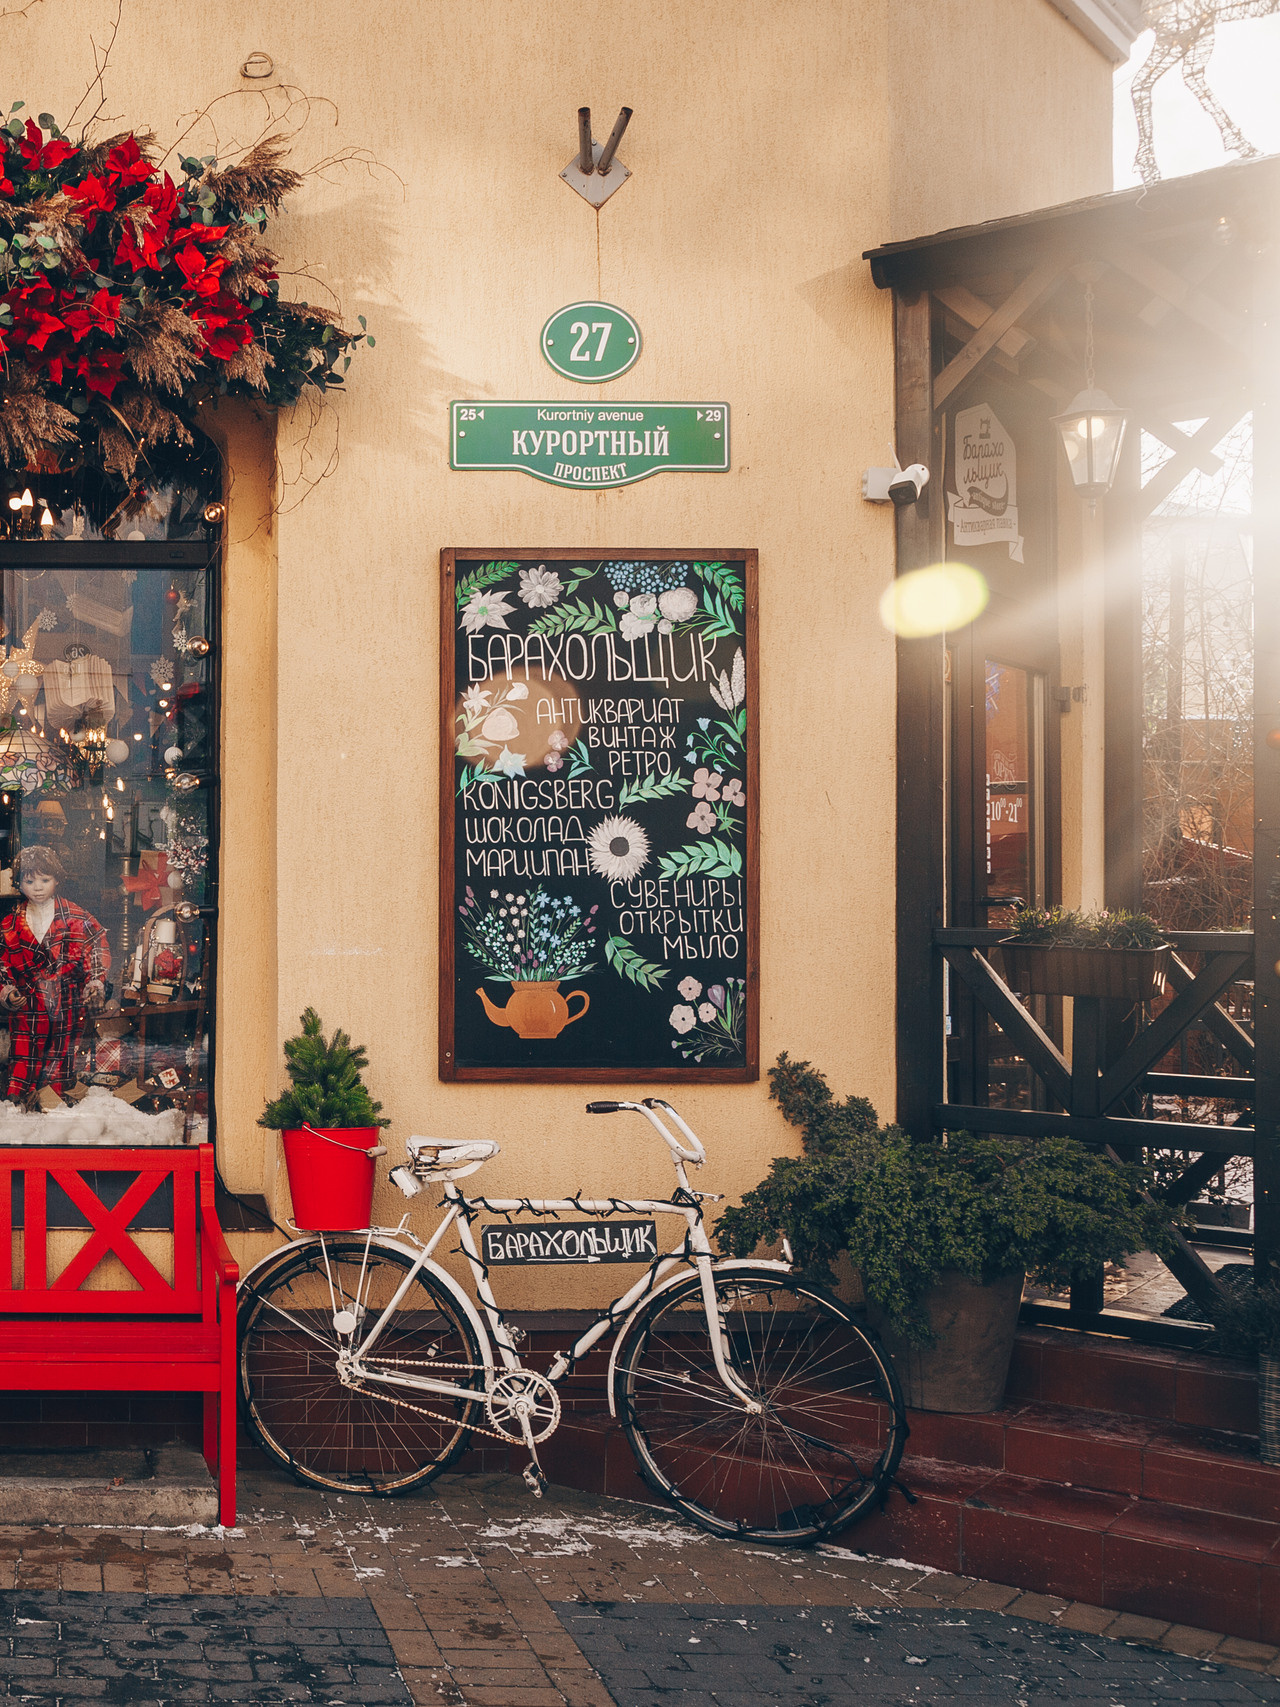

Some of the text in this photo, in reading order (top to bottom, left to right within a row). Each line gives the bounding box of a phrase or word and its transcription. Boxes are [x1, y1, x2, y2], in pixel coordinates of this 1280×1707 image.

[570, 321, 612, 362] 27
[459, 408, 477, 421] 25
[537, 409, 644, 423] Kurortniy avenue
[705, 409, 721, 421] 29
[511, 425, 670, 456] КУРОРТНЫЙ
[962, 434, 1005, 461] Барахо
[552, 461, 627, 481] ПРОСПЕКТ
[468, 632, 721, 689] БАРАХОЛЬЩИК
[535, 697, 685, 725] АНТИКВАРИАТ
[588, 725, 677, 749] ВИНТАЖ
[609, 750, 671, 776] РЕТРО
[462, 778, 615, 811] KÖNIGSBERG
[464, 815, 589, 844] ШОКОЛАД
[465, 848, 592, 880] МАРЦИПАН
[610, 878, 743, 910] СУВЕНИРЫ
[619, 907, 744, 936] ОТКРЫТКИ
[662, 934, 740, 960] МЫЛО
